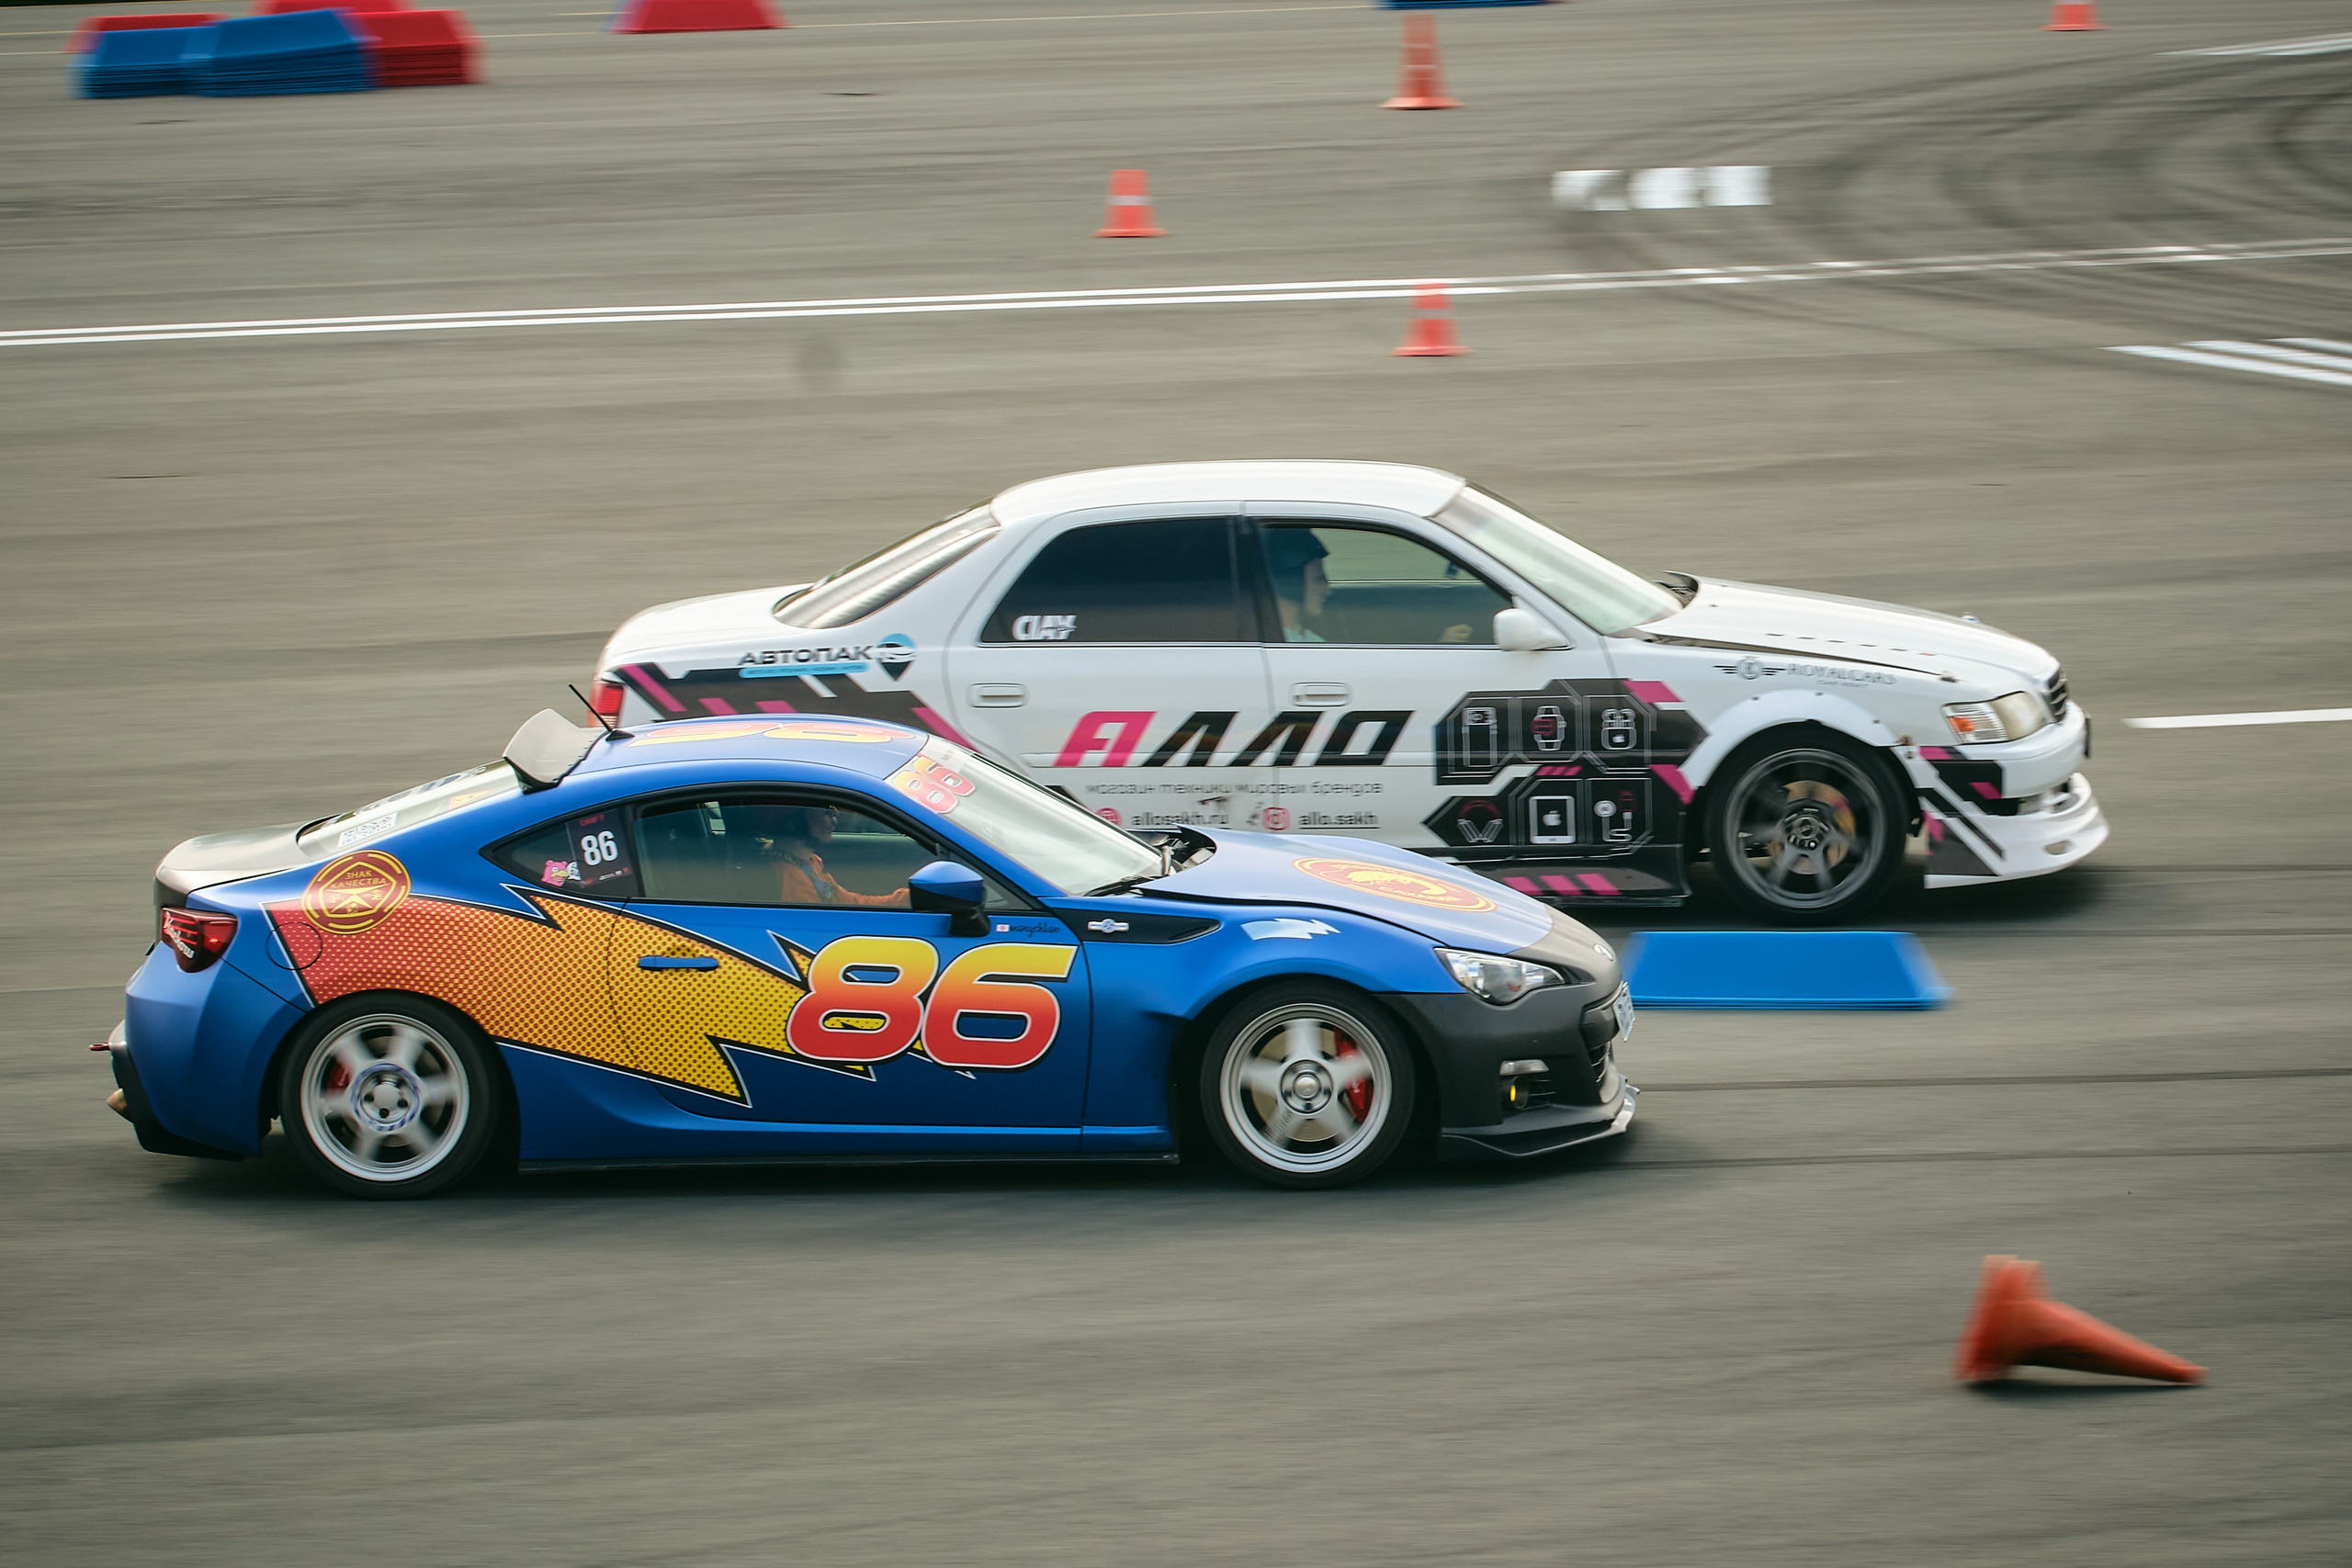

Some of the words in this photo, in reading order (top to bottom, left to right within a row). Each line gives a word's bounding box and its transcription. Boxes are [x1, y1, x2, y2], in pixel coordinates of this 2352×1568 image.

[737, 645, 875, 665] АВТОПАК
[892, 754, 976, 814] 86
[581, 830, 619, 866] 86
[331, 877, 387, 889] КАЧЕСТВА
[345, 870, 372, 880] ЗНАК
[786, 934, 1080, 1069] 86
